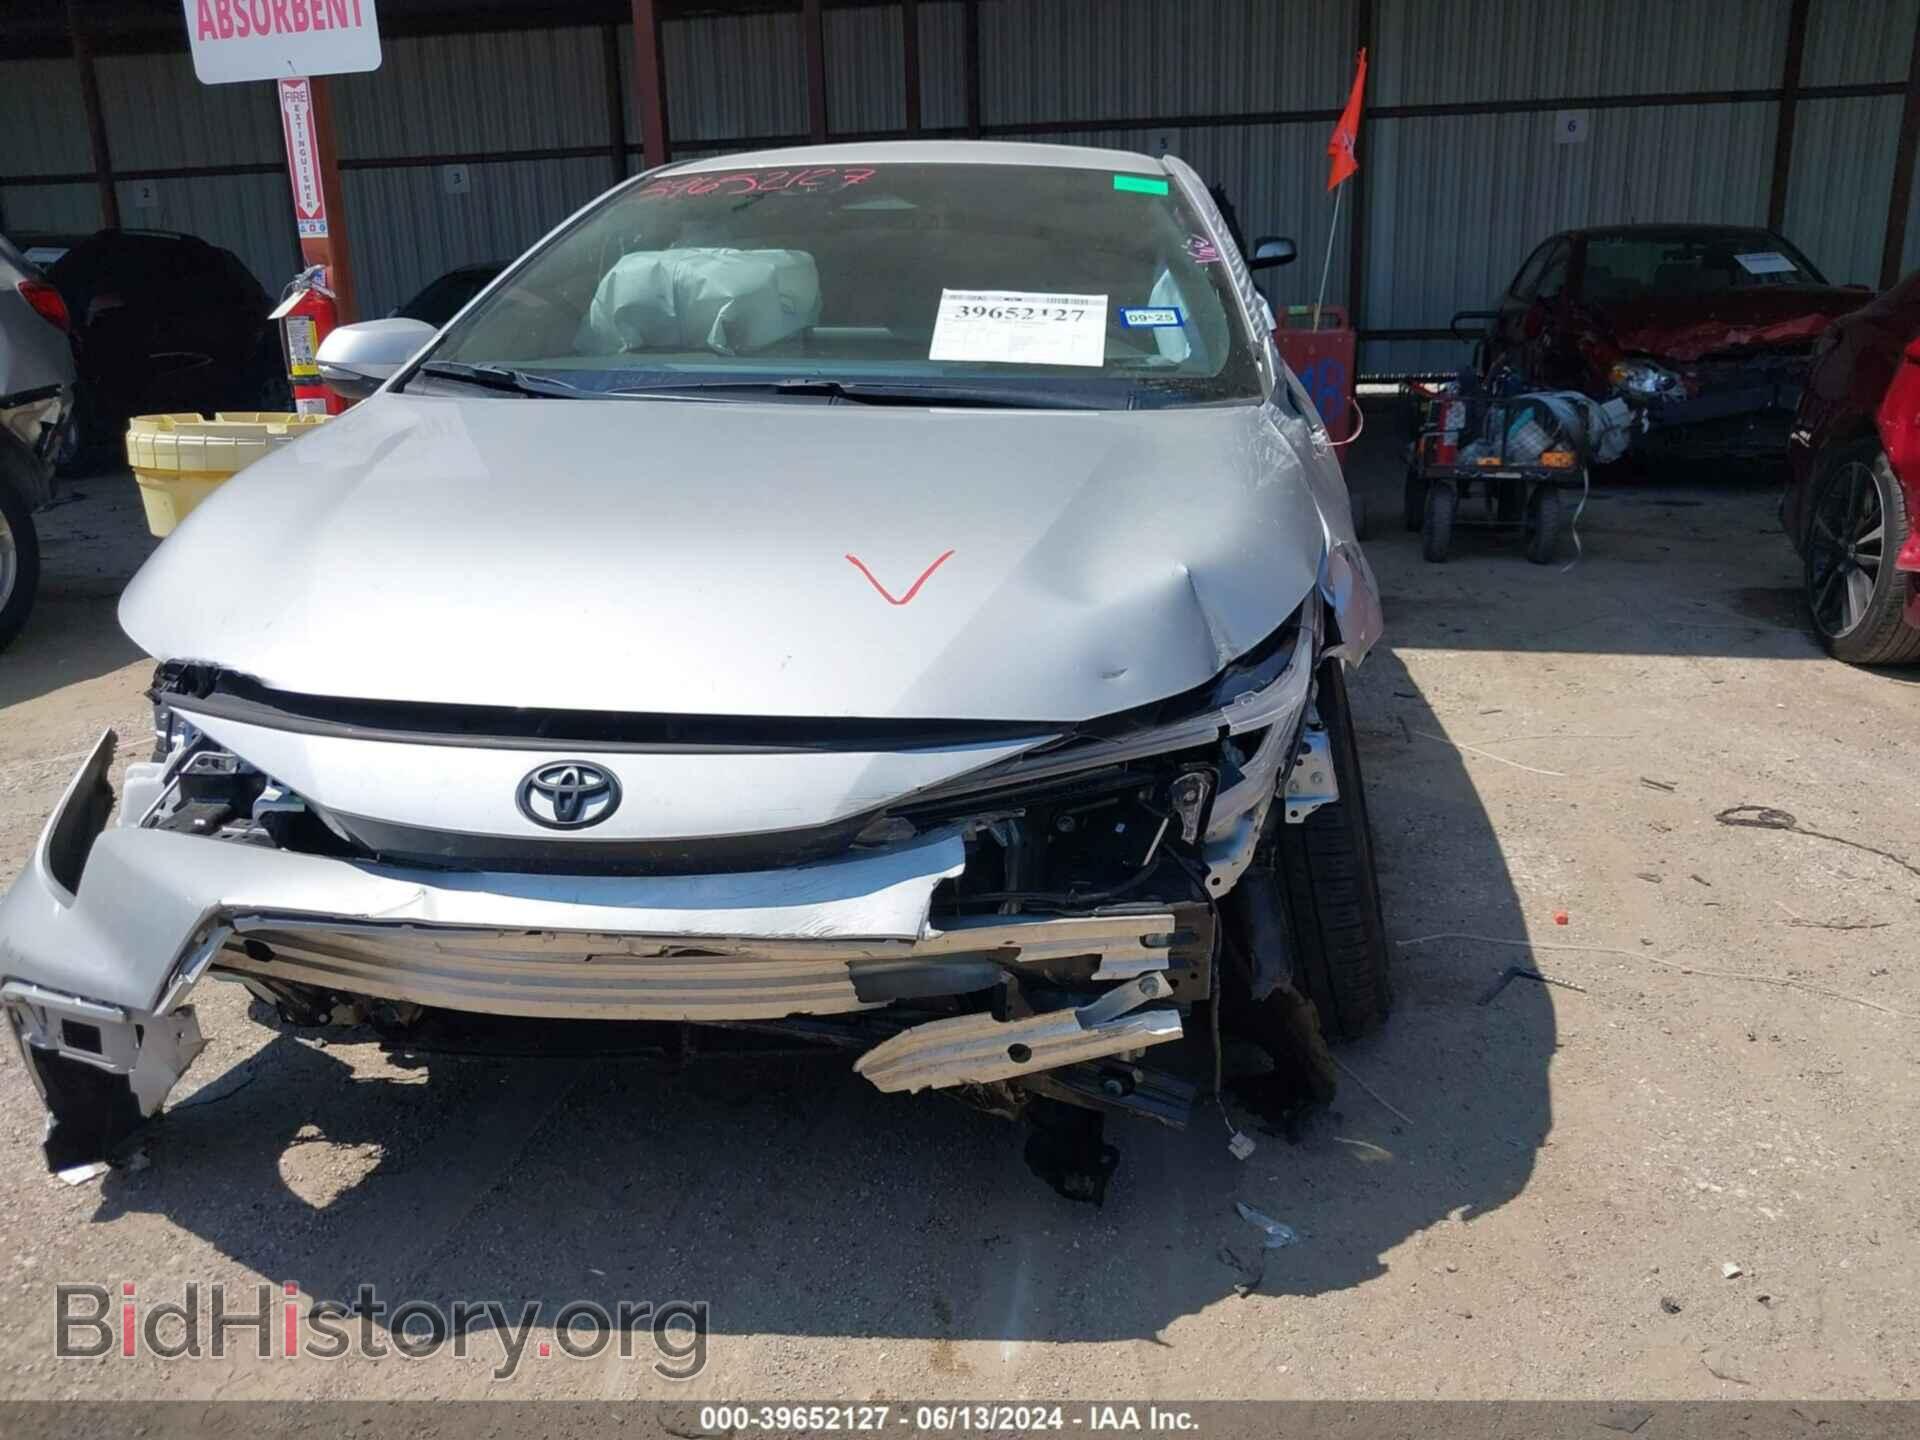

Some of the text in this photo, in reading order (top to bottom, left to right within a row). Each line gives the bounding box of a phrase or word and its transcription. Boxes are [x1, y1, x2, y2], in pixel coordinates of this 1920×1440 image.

[197, 0, 363, 41] ABSORBENT
[285, 91, 307, 102] FIRE
[1567, 120, 1577, 133] 6
[294, 104, 313, 209] EXTINGUISHER
[955, 304, 1085, 322] 39652127
